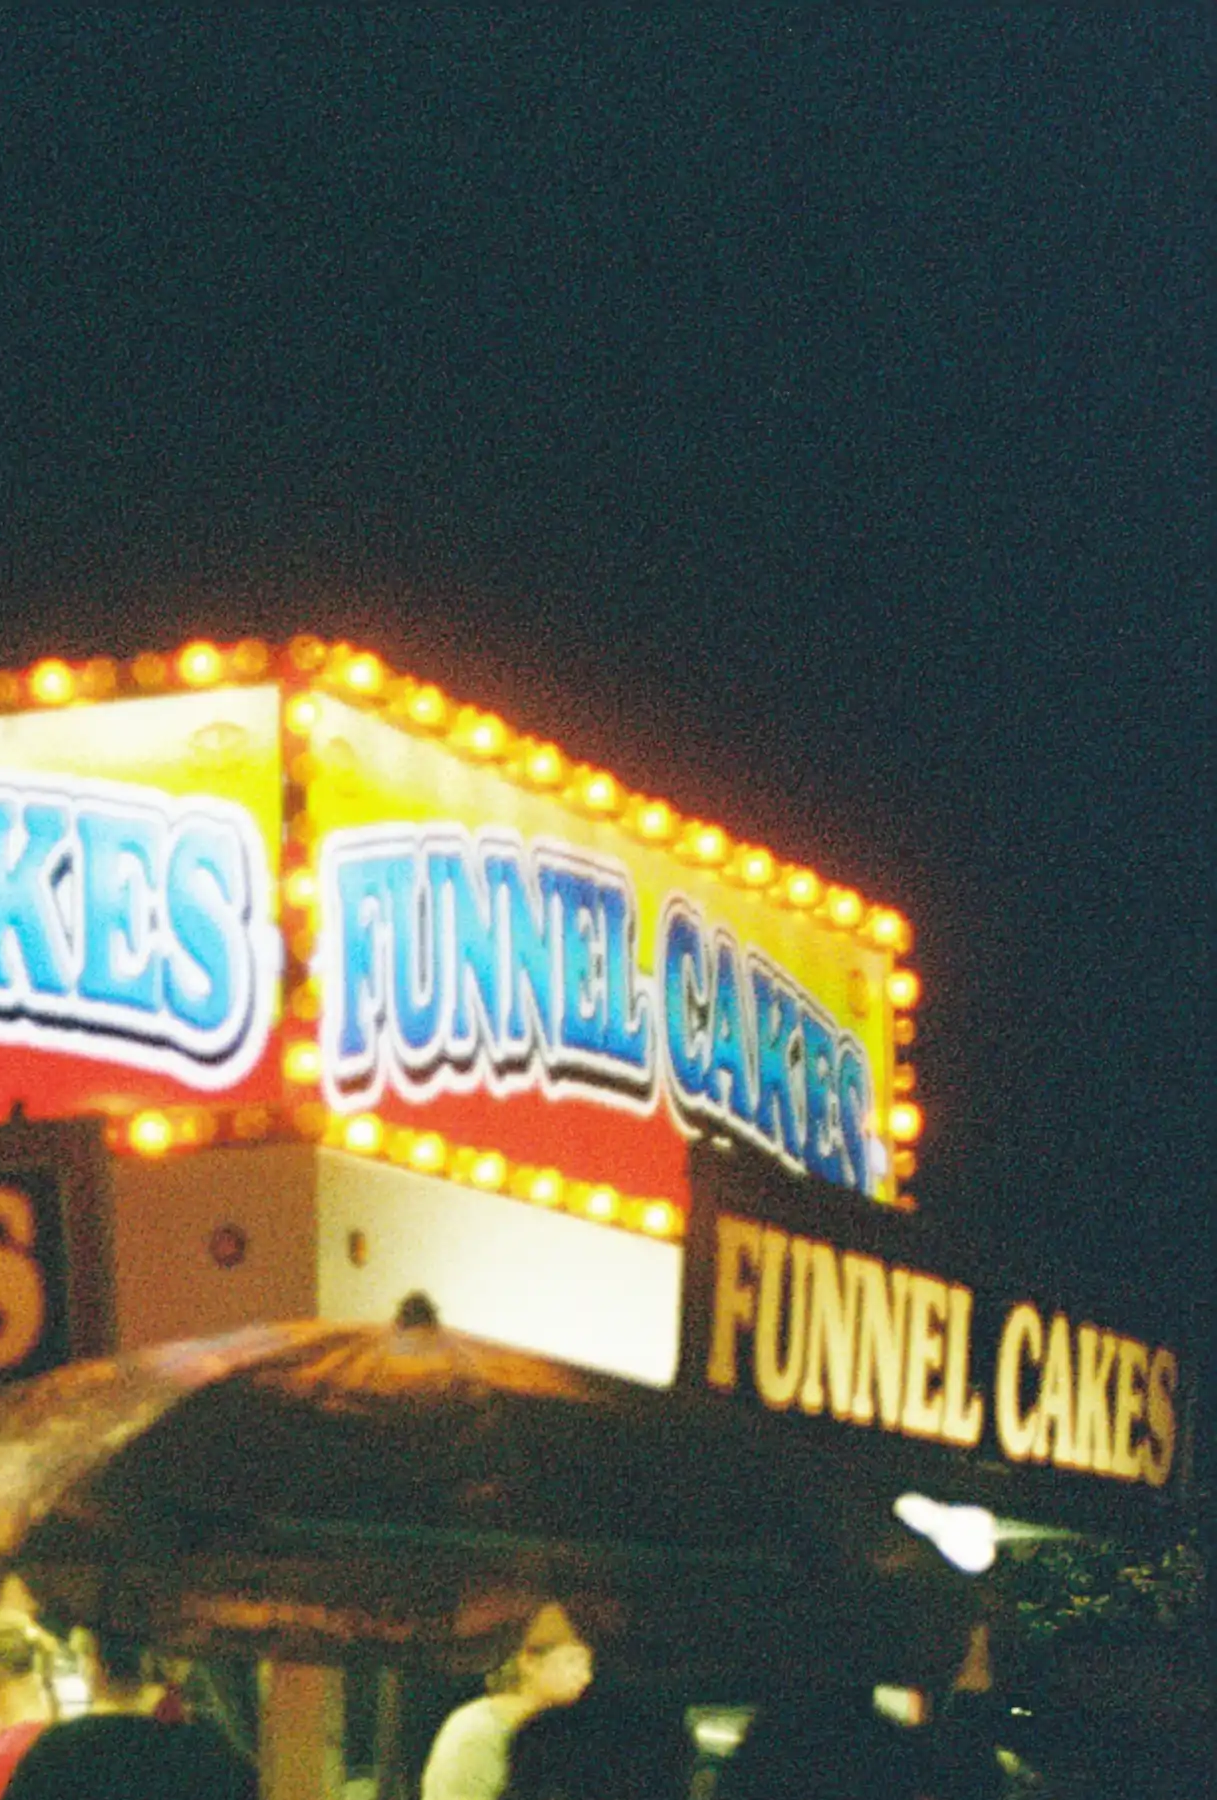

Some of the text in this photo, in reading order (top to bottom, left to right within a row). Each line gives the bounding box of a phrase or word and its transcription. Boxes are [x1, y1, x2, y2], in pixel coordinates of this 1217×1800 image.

[337, 845, 876, 1196] FUNNEL CAKES
[707, 1214, 1180, 1490] FUNNEL CAKES
